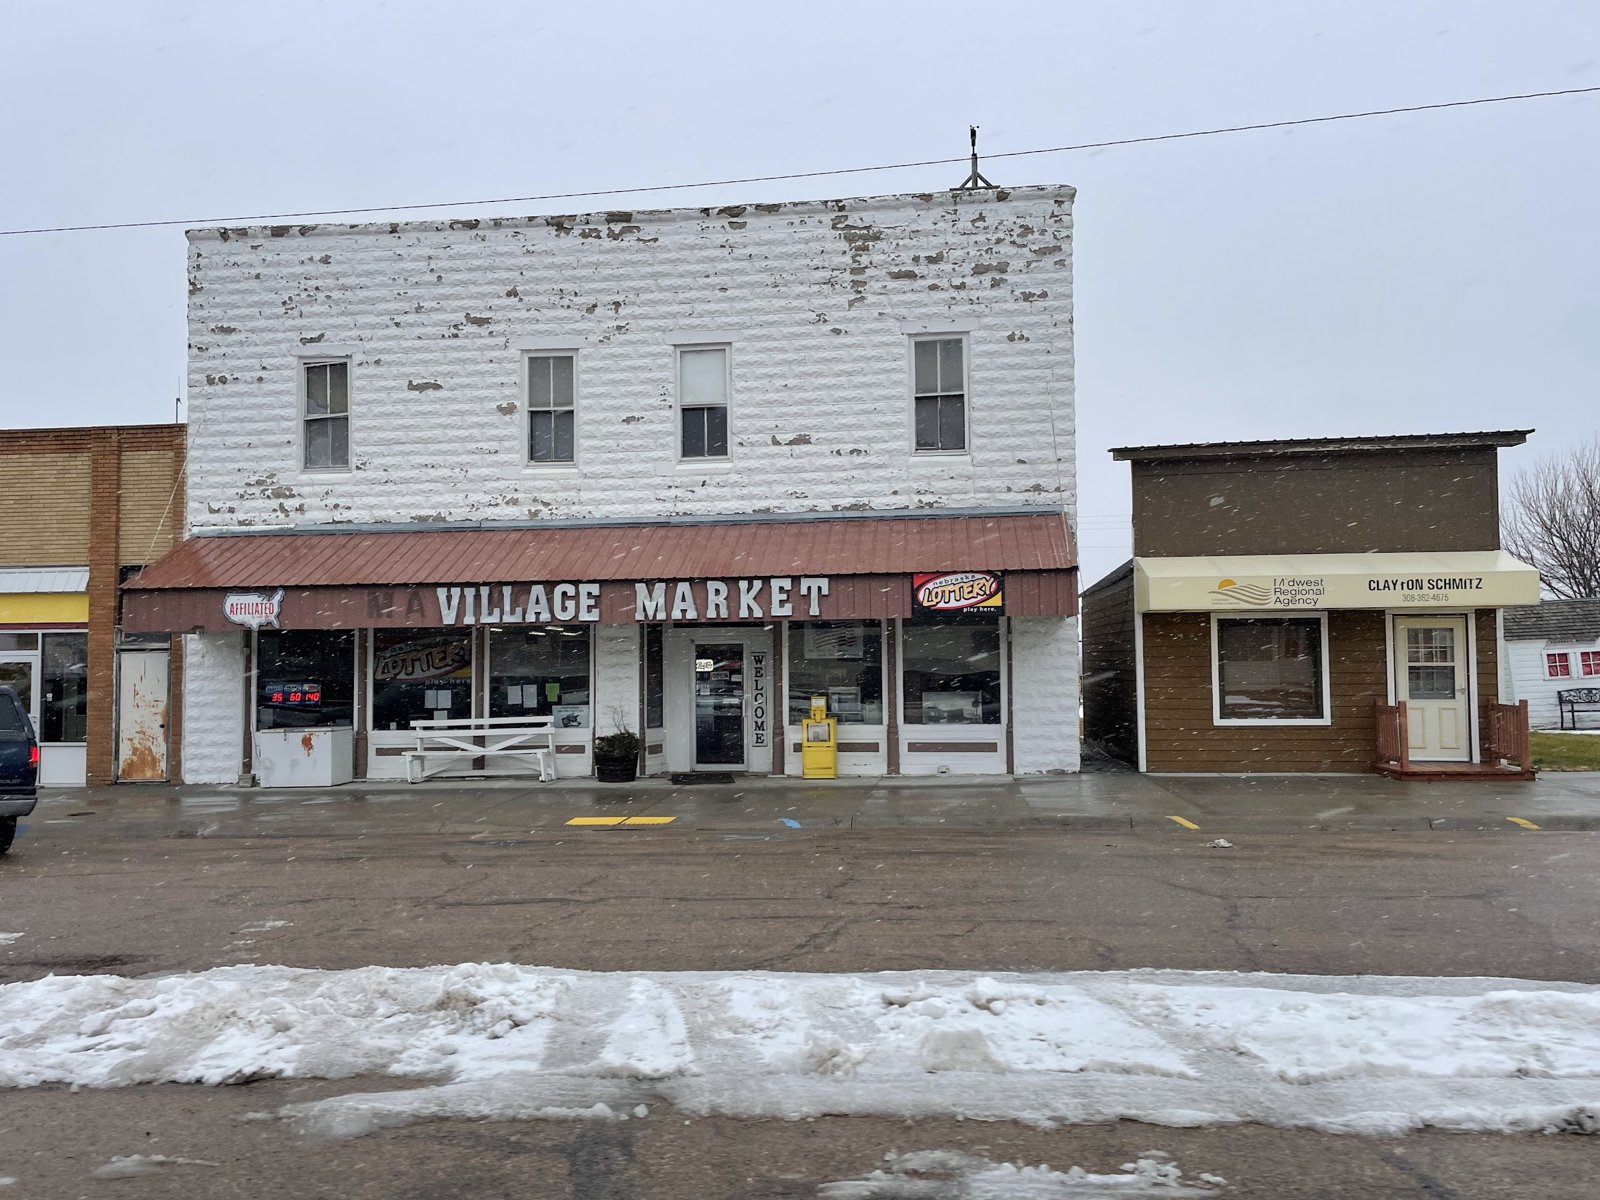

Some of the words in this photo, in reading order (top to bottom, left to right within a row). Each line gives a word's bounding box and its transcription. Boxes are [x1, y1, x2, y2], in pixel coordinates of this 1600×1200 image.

[933, 574, 976, 586] nebraska
[1273, 578, 1324, 587] Mdwest
[1368, 579, 1424, 591] CLAYTON
[1427, 578, 1483, 590] SCHMITZ
[922, 577, 994, 607] LOTTERY
[1273, 587, 1325, 598] Regional
[436, 583, 600, 625] VILLAGE
[634, 577, 829, 621] MARKET
[1273, 596, 1319, 607] Agency
[229, 602, 275, 615] AFFILIATED
[272, 692, 283, 702] 35
[289, 692, 302, 702] 60
[306, 692, 320, 702] 140
[753, 655, 766, 744] WELCOME
